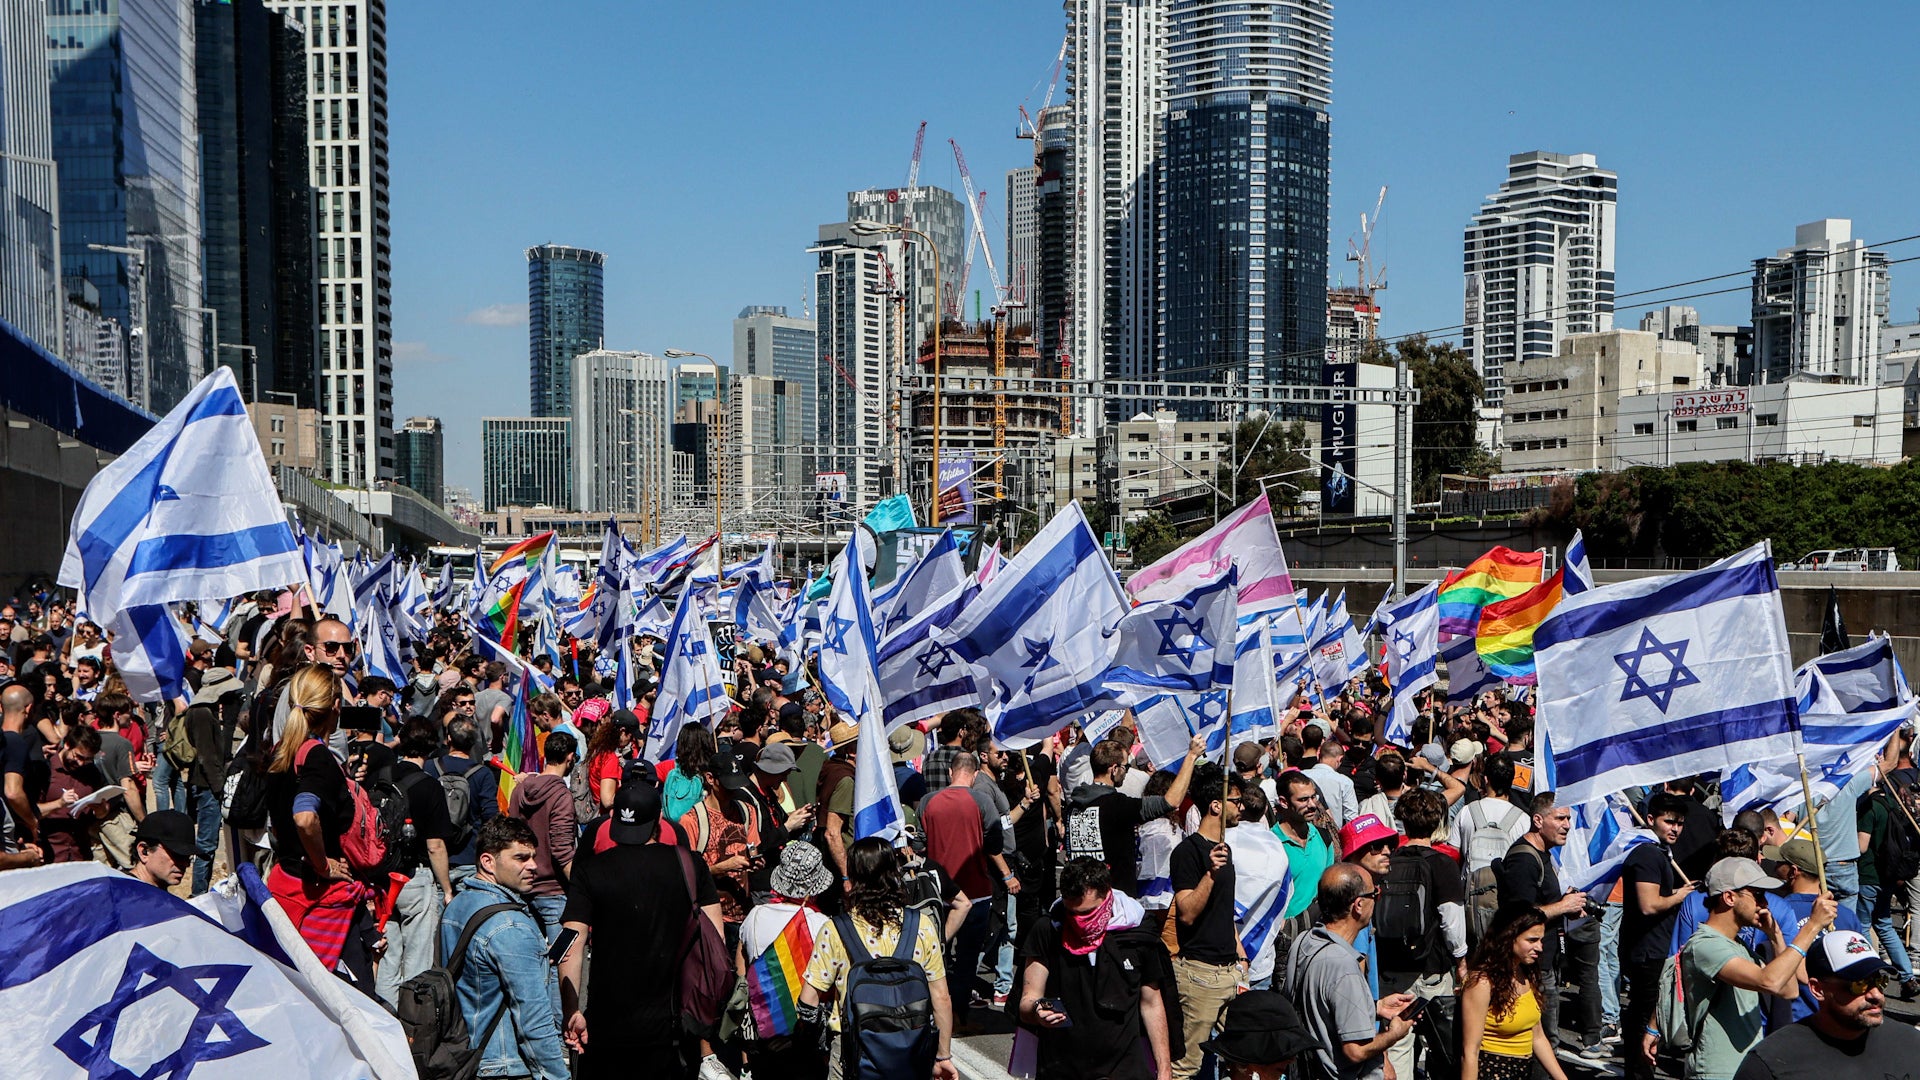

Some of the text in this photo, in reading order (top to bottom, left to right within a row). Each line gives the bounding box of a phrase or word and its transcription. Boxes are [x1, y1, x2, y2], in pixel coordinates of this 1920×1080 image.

[1170, 109, 1188, 121] IBM
[1315, 111, 1328, 124] IBM
[853, 190, 885, 206] ATRIUM
[1675, 391, 1746, 406] להשכרה
[1333, 370, 1345, 457] MUGLER
[939, 467, 966, 482] Milka
